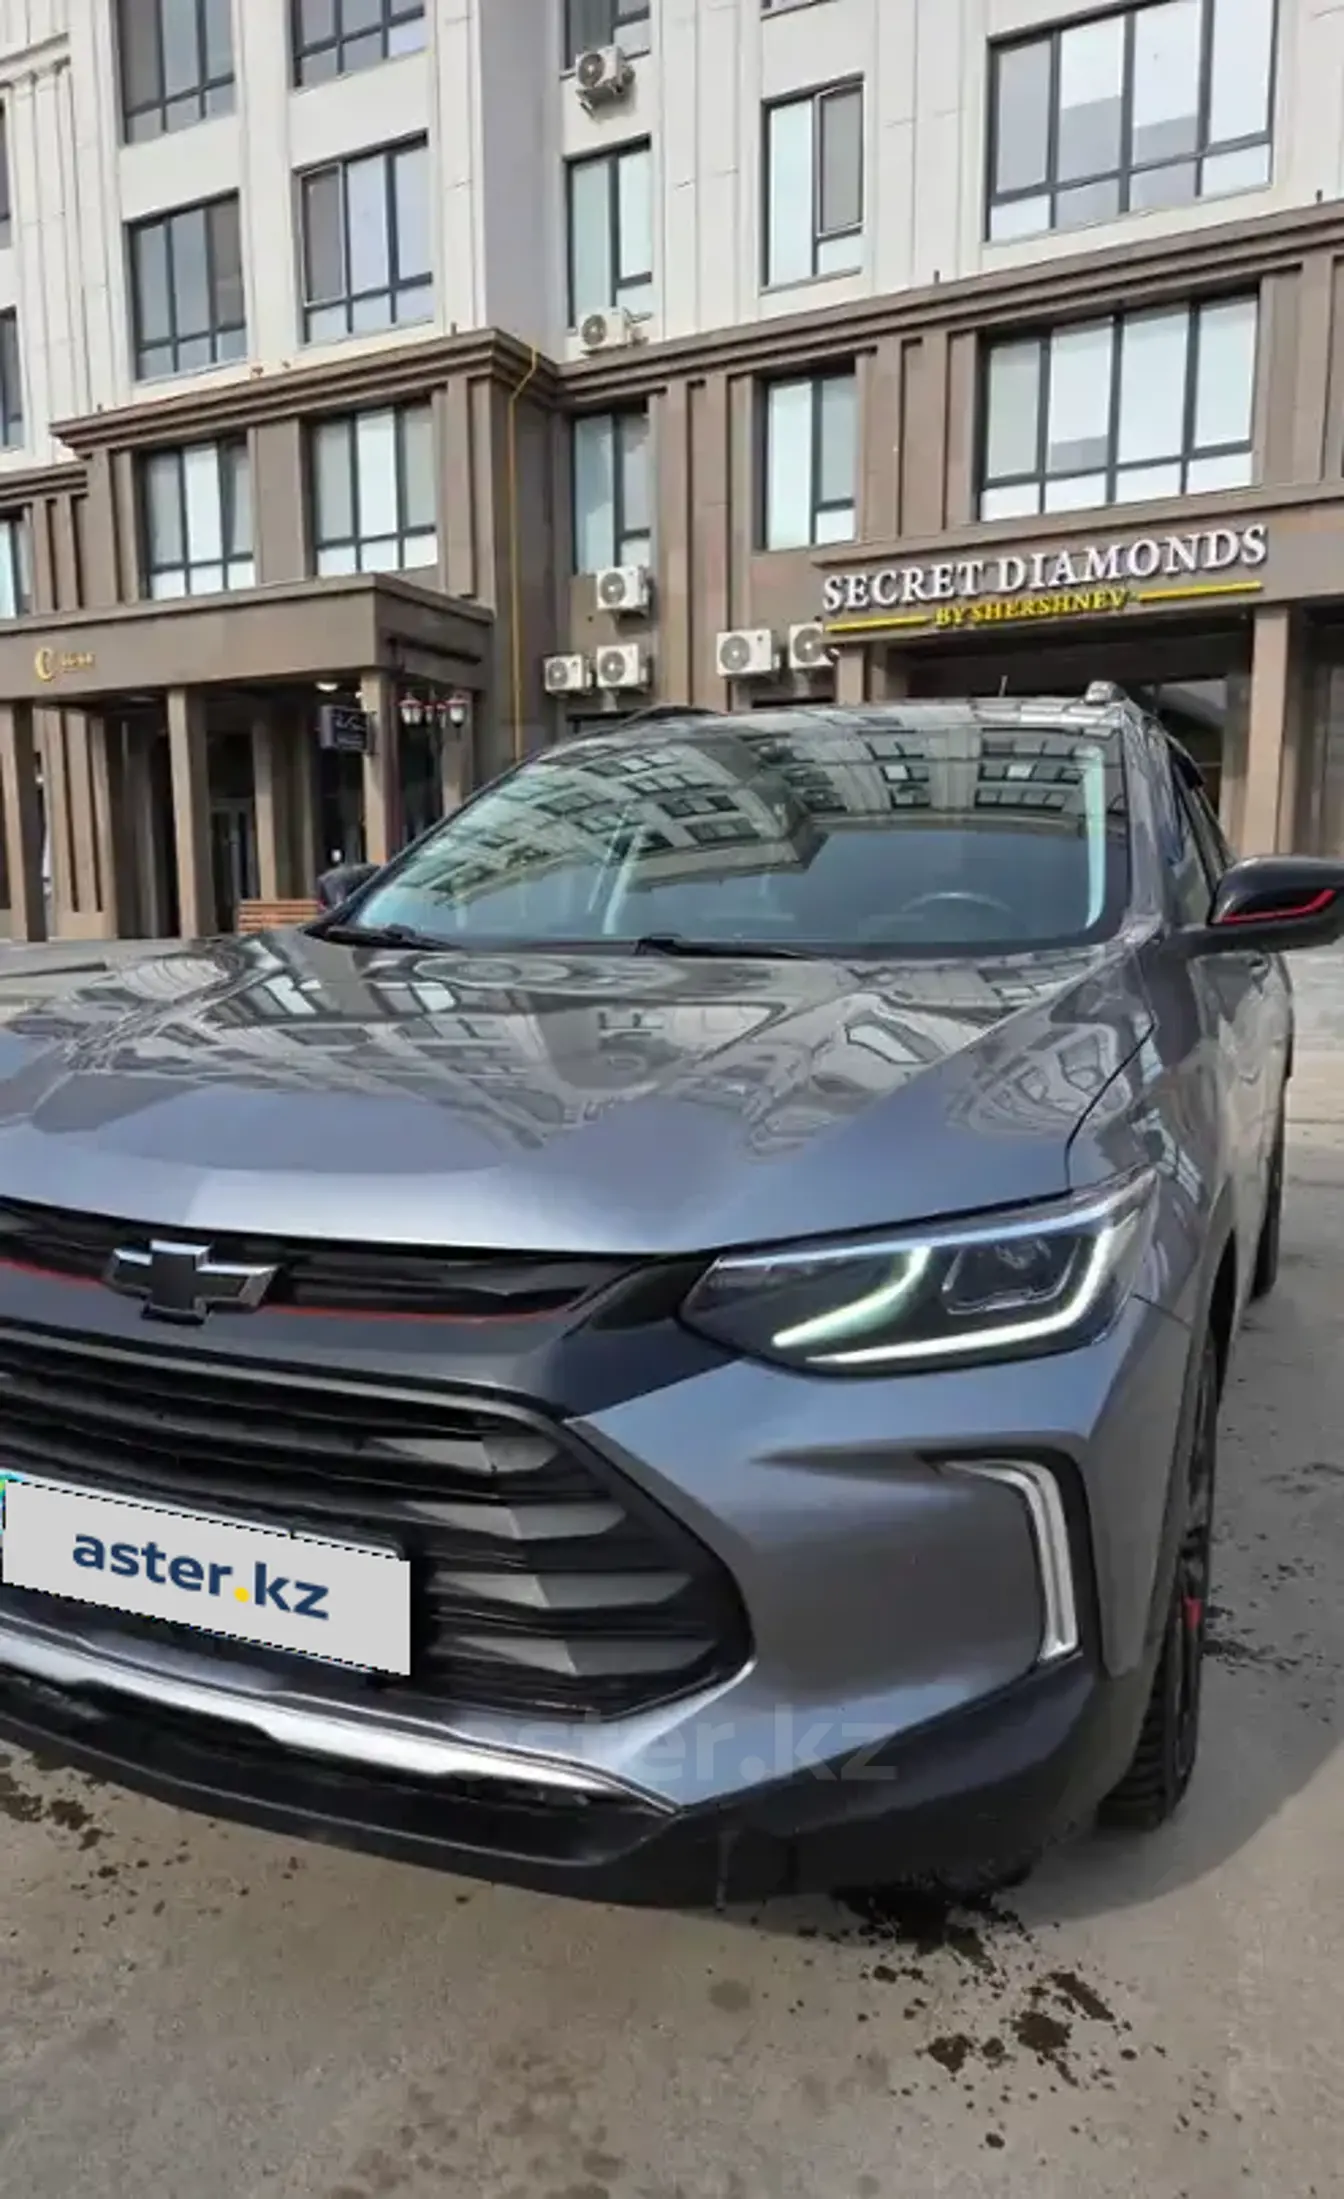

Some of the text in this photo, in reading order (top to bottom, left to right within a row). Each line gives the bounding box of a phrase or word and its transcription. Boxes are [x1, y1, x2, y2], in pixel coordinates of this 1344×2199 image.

[823, 523, 1269, 611] SECRET DIAMONDS
[934, 589, 1130, 626] BY SHERSHNEV
